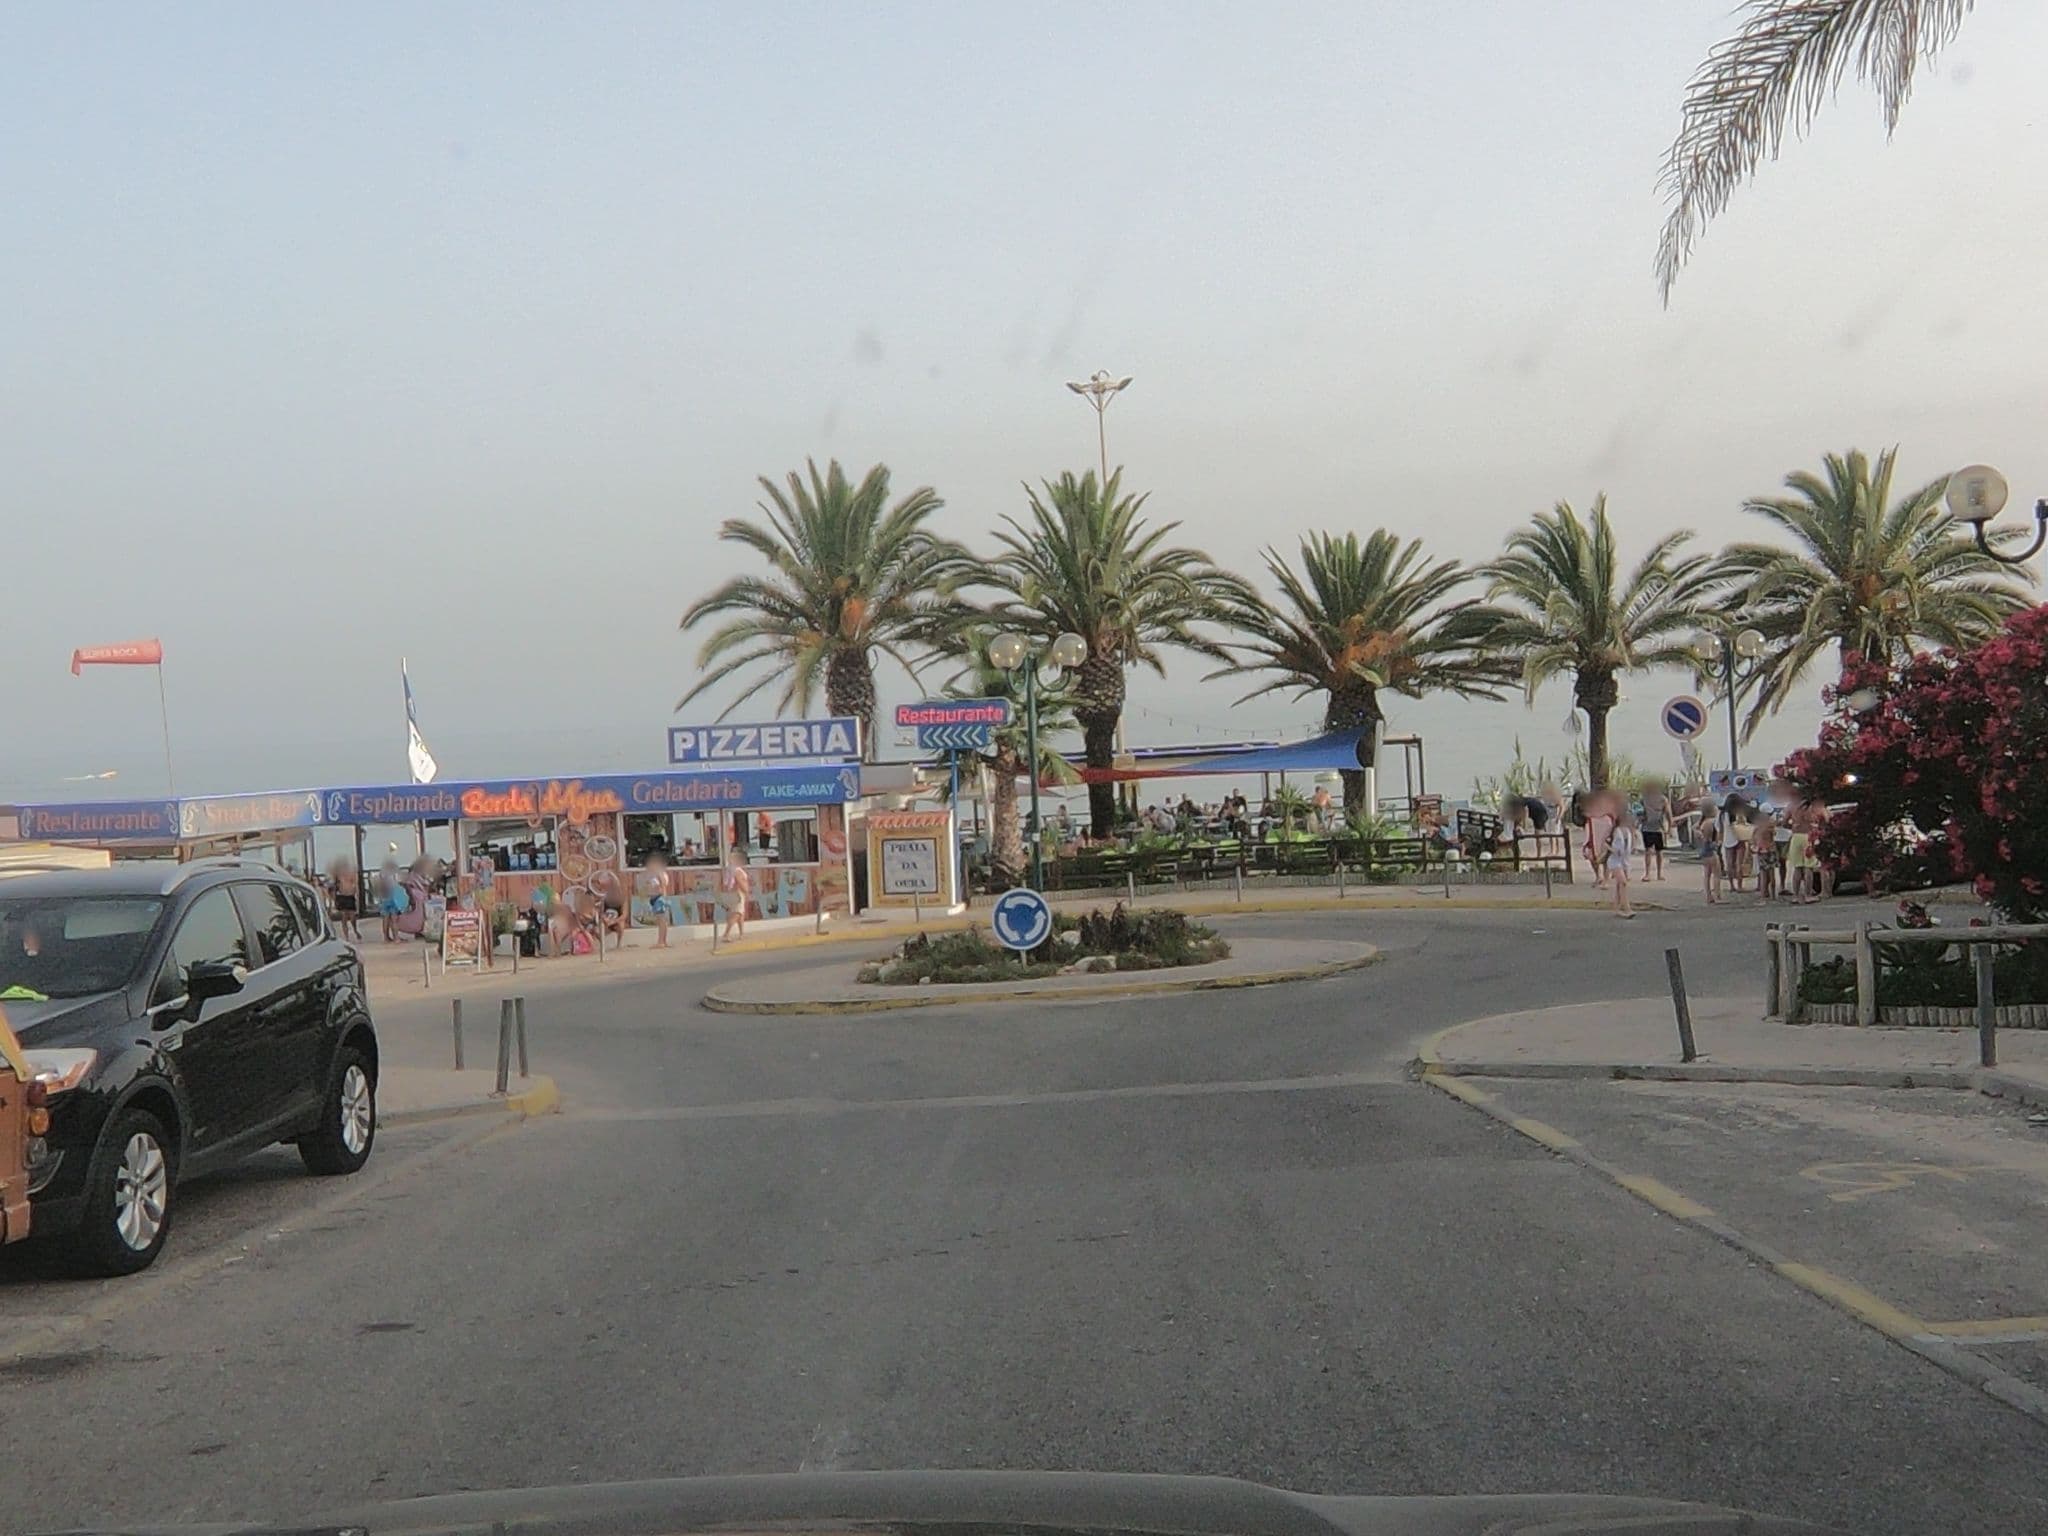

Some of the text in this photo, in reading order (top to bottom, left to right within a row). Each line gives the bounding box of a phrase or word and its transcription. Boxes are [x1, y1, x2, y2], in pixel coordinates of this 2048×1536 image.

[896, 706, 1006, 724] Restaurante
[674, 724, 851, 759] PIZZERIA
[632, 778, 742, 803] Geladaria
[761, 783, 836, 797] TAKE-AWAY
[349, 791, 455, 817] Esplanada
[35, 811, 161, 832] Restaurante
[890, 843, 928, 853] PRAIA
[902, 862, 918, 870] DA
